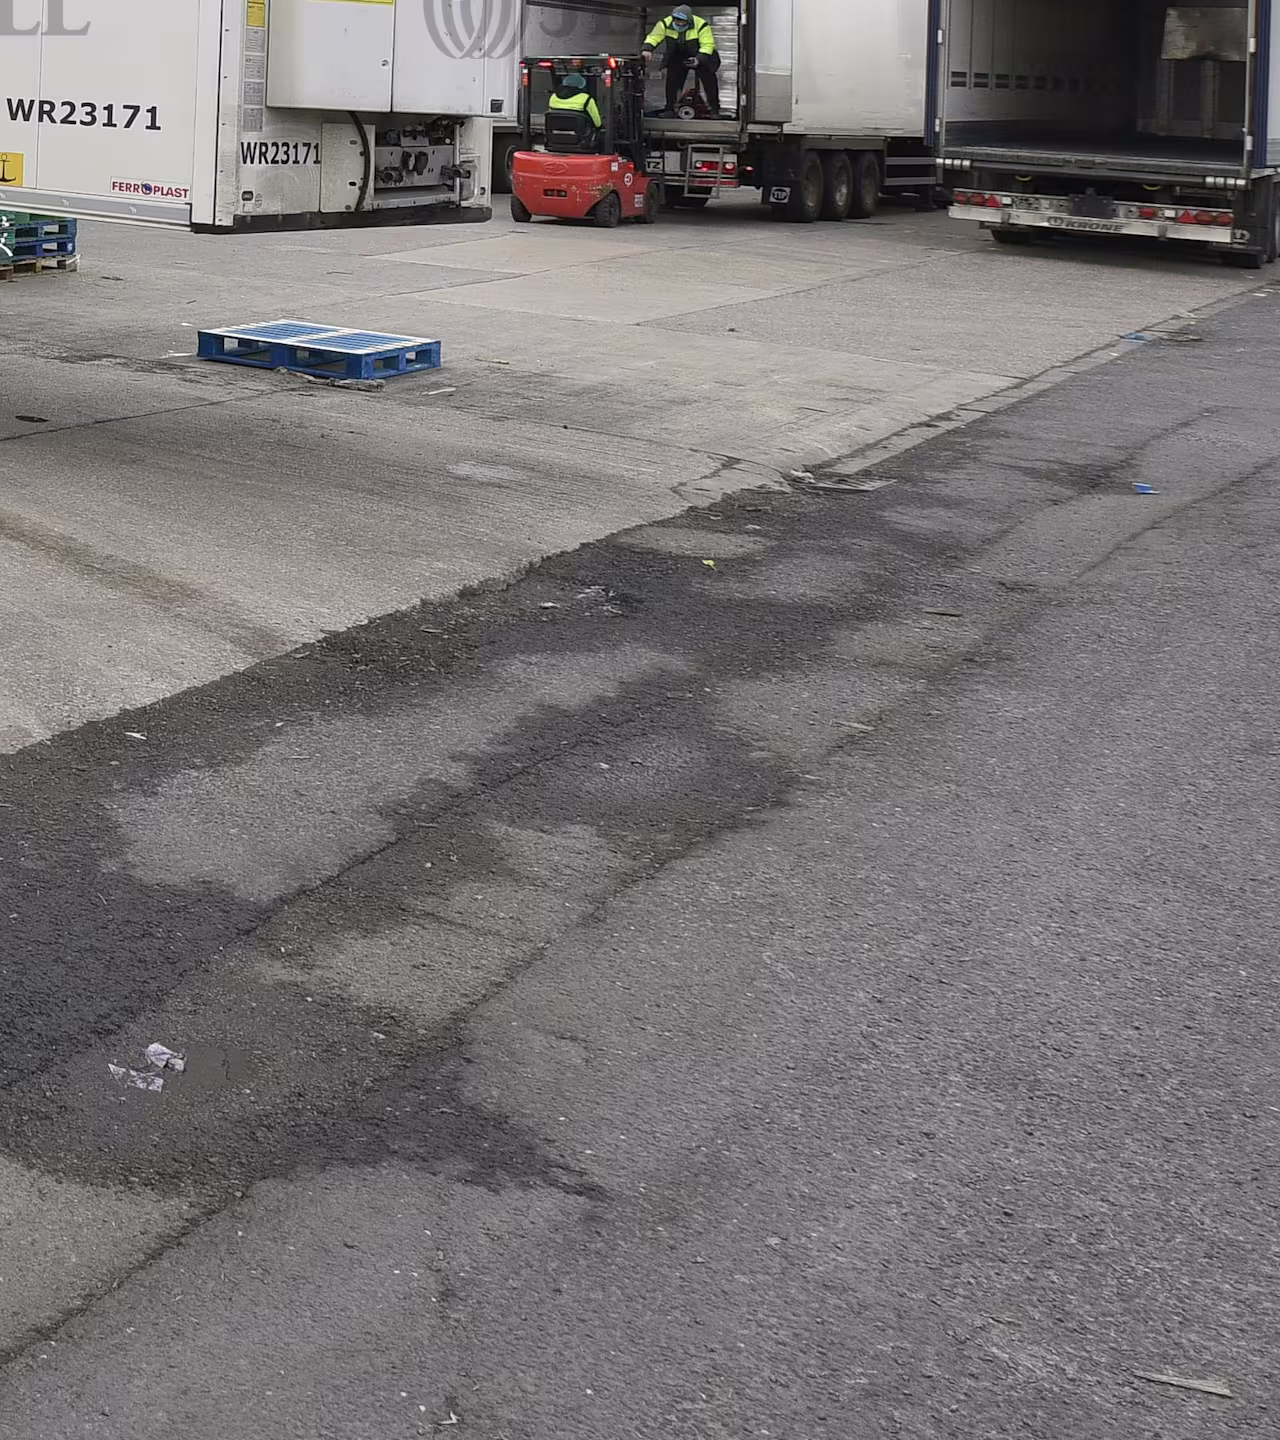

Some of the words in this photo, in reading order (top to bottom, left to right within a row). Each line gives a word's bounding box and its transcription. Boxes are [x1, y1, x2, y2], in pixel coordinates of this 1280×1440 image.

[6, 97, 162, 131] WR23171
[240, 140, 321, 165] WR23171
[772, 190, 788, 200] TIP
[1065, 219, 1124, 233] KRONE
